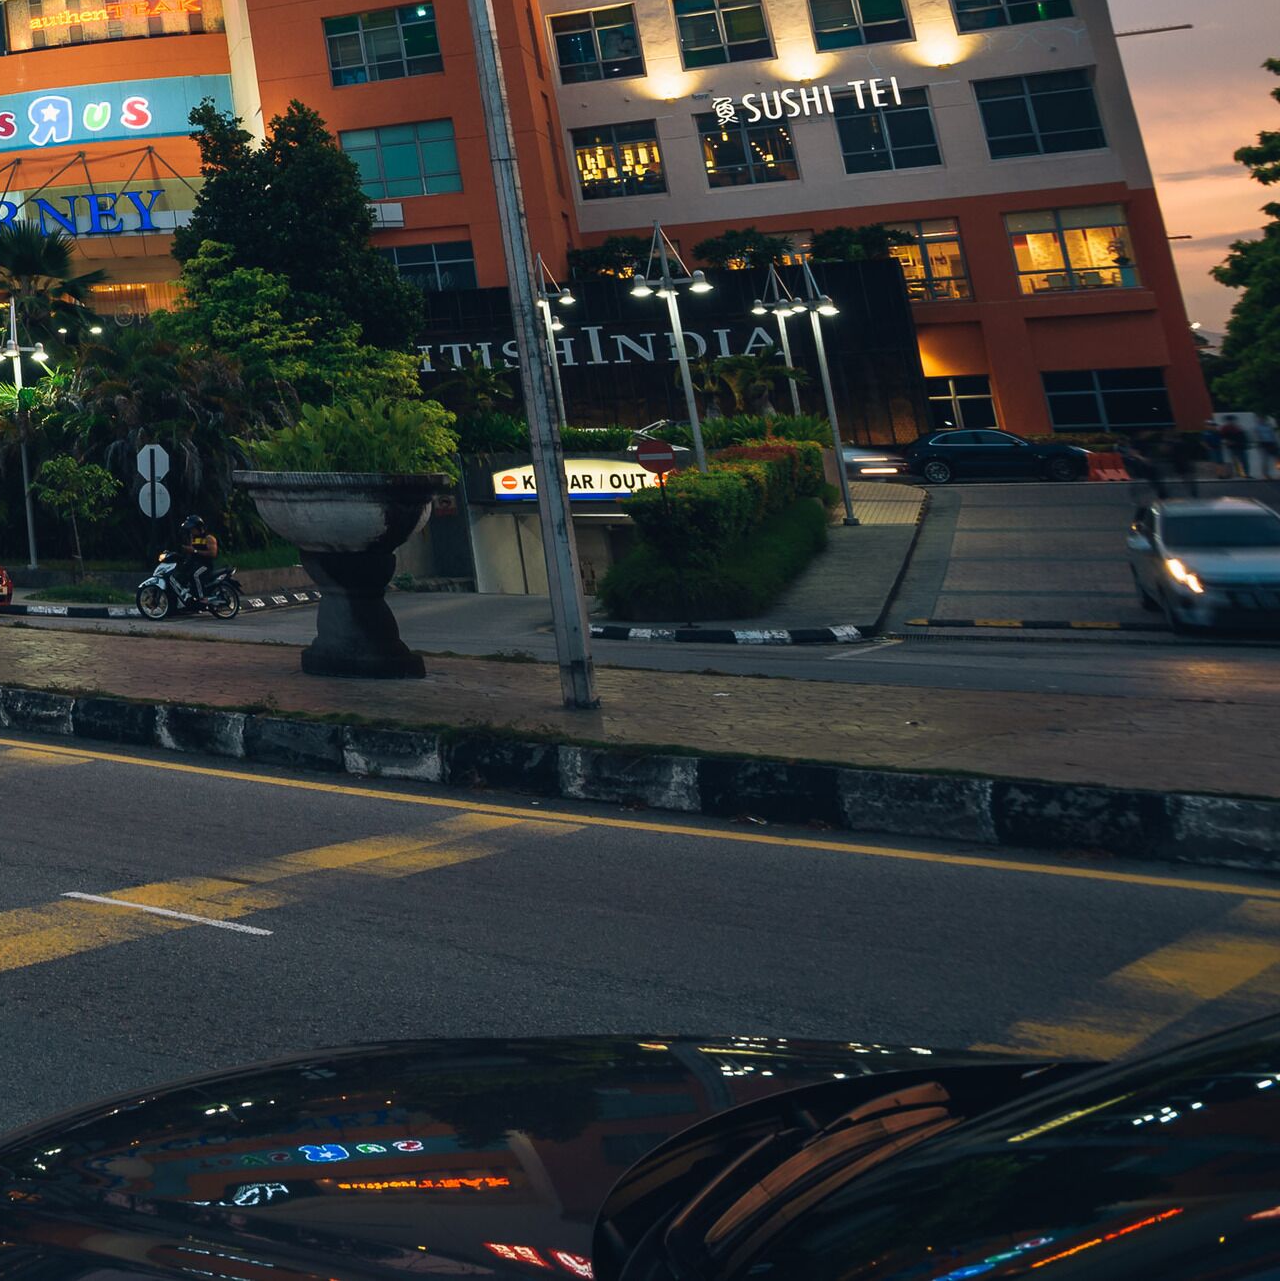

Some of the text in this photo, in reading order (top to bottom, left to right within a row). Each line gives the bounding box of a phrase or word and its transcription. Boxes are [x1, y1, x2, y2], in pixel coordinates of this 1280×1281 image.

[742, 76, 902, 122] SUSHI TEI
[522, 474, 594, 489] KAR
[610, 473, 647, 489] OUT
